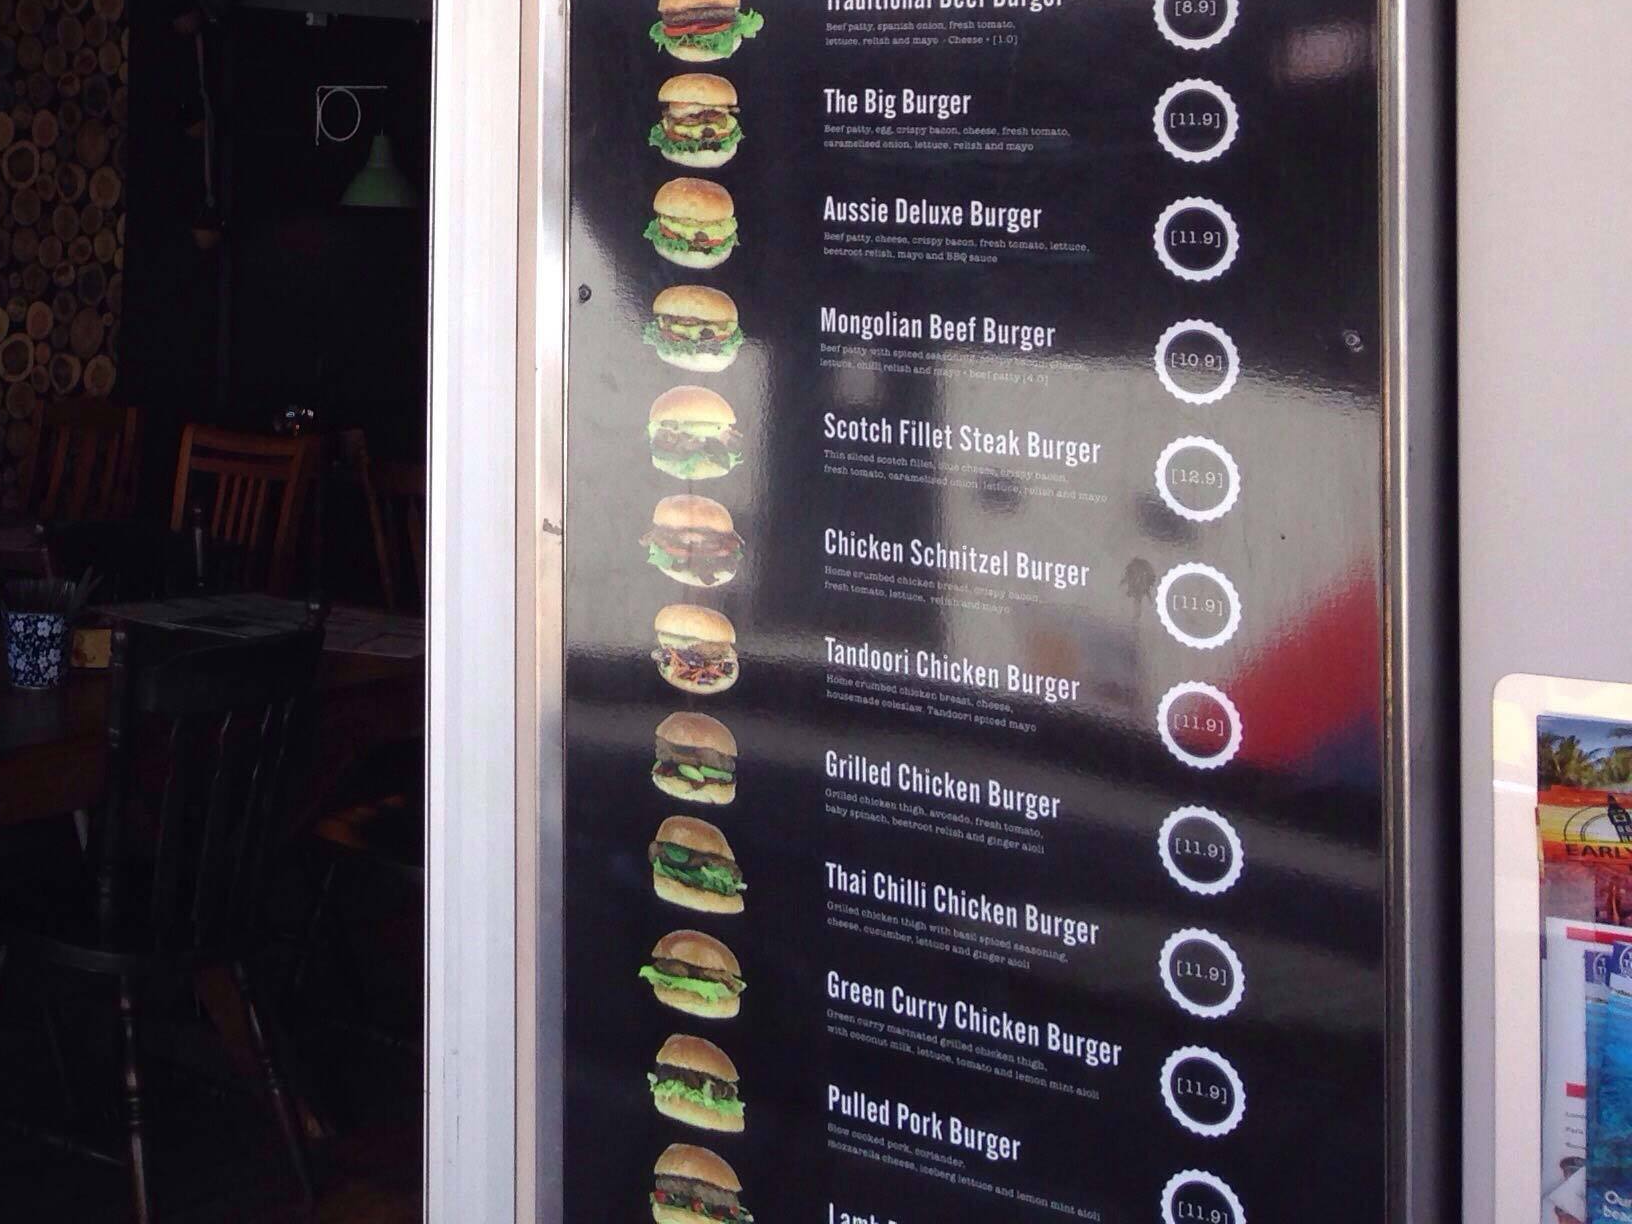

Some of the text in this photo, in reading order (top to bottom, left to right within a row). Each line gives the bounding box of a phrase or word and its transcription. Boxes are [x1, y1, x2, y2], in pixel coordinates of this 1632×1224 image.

[824, 89, 972, 119] The Big Burger
[1170, 110, 1221, 130] [11.9]
[824, 196, 1042, 233] Aussie Deluxe Burger
[1170, 228, 1221, 249] [11.9]
[821, 307, 1056, 351] Mongolian Beef Burger
[824, 412, 1101, 467] Scotch Fillet Steak Burger
[825, 528, 1090, 589] Chicken Schnitzel Burger
[1172, 594, 1223, 617] [11.9]
[825, 636, 1080, 703] Tandoori Chicken Burger
[1173, 713, 1224, 737] [11.9]
[825, 750, 1061, 820] Grilled Chicken Burger
[1174, 836, 1226, 862] [11.9]
[825, 862, 1100, 946] Thai Chilli Chicken Burger
[1176, 960, 1227, 987] [11.9]
[827, 970, 1122, 1067] Green Curry Chicken Burger
[1176, 1076, 1228, 1105] [11.9]
[828, 1084, 1022, 1161] Pulled Pork Burger
